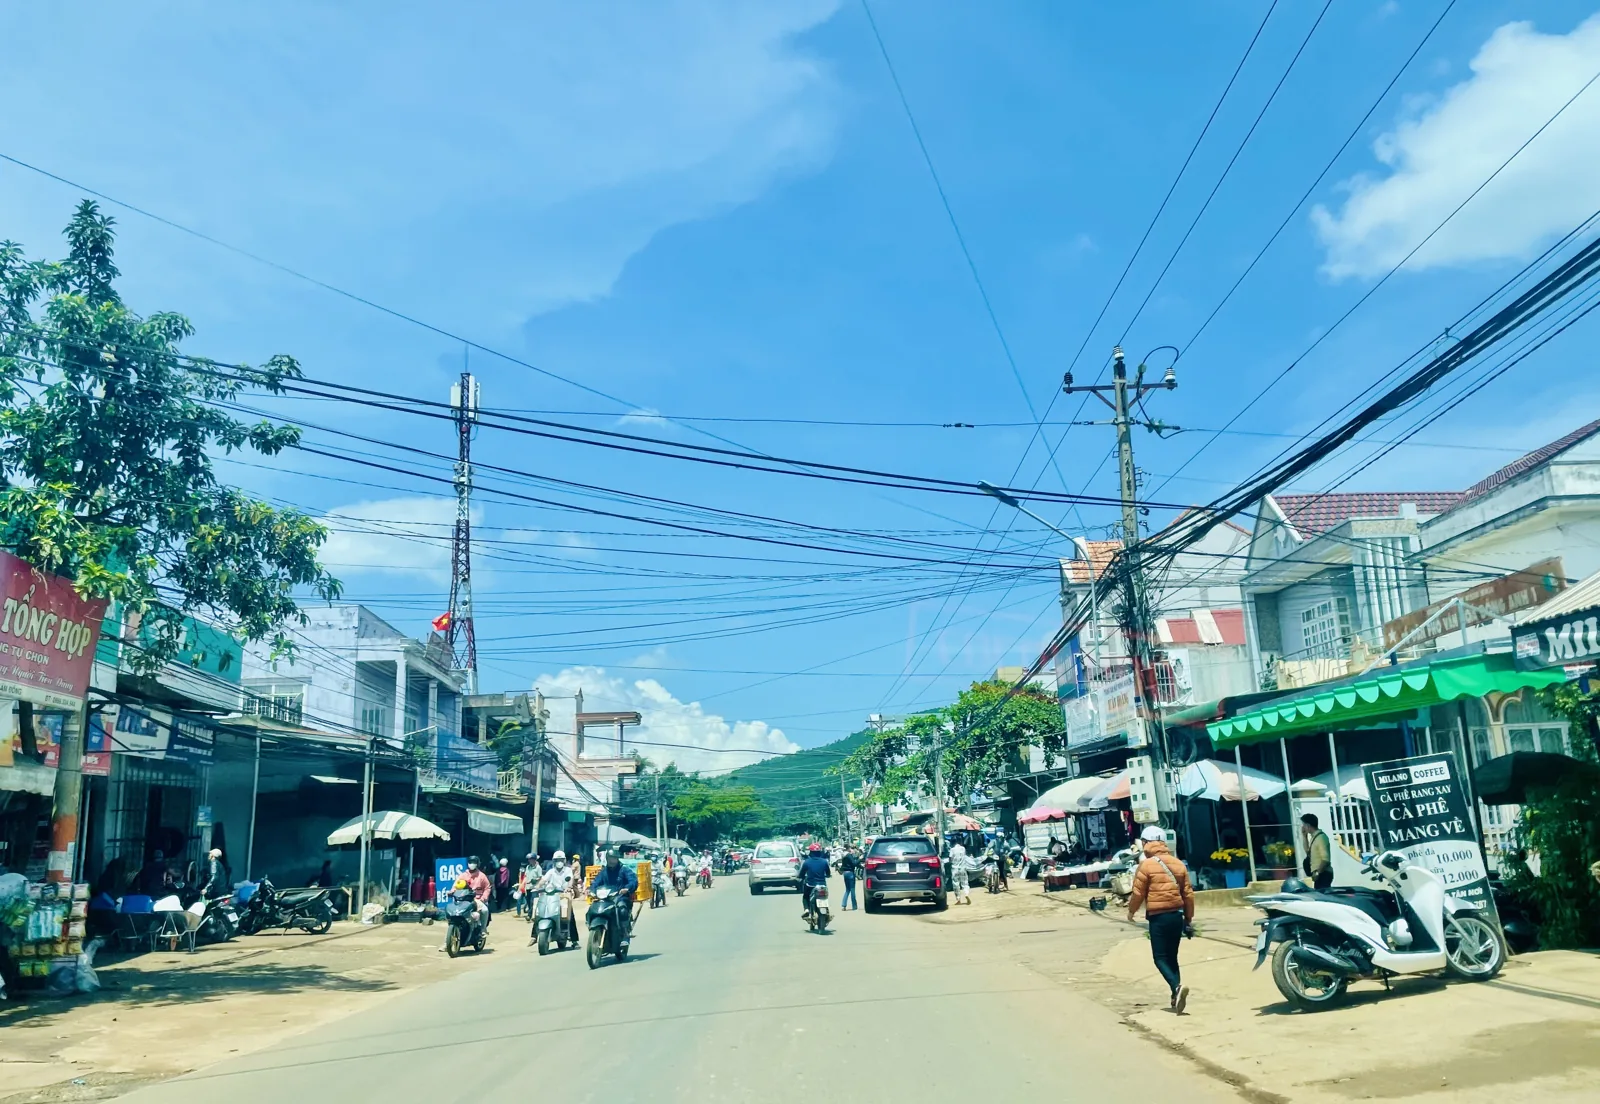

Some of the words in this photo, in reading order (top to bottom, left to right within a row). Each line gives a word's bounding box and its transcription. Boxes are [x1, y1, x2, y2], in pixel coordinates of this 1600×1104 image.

[1, 584, 58, 646] TỔNG
[55, 619, 92, 661] HỢP
[25, 650, 50, 666] CHỌN
[1378, 773, 1408, 784] MILANO
[1413, 766, 1445, 779] COFFEE
[1380, 791, 1393, 803] CÀ
[1393, 788, 1410, 801] PHÊ
[1411, 786, 1435, 799] RANG
[1435, 784, 1452, 795] XAY
[1389, 803, 1414, 821] CÀ
[1415, 797, 1450, 818] PHÊ
[1388, 823, 1440, 843] MANG
[1441, 816, 1466, 835] VỀ
[1436, 849, 1473, 864] 10.000
[439, 864, 464, 882] GAS
[1442, 869, 1479, 884] 12.000
